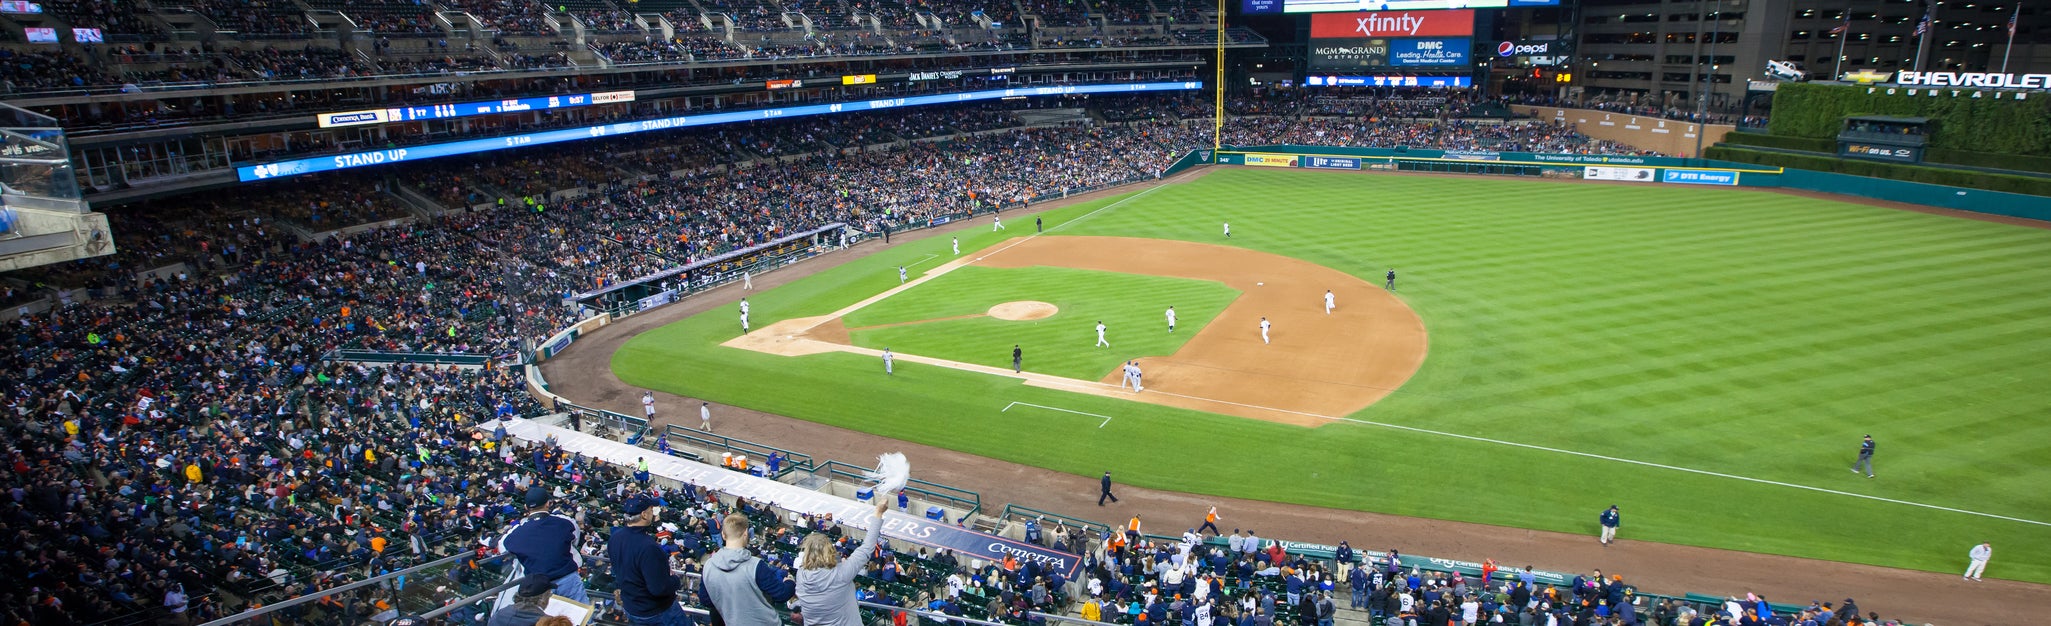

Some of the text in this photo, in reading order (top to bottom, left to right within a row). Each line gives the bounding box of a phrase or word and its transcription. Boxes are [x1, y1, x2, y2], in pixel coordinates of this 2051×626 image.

[1355, 12, 1425, 36] xfinity
[1315, 46, 1384, 55] MGM GRAND
[1417, 41, 1443, 50] DMC
[1515, 43, 1548, 55] pepsi
[896, 98, 905, 106] UP
[642, 119, 670, 130] STAND
[673, 117, 686, 126] UP
[1869, 147, 1879, 155] on
[334, 149, 407, 168] STAND UP
[1313, 157, 1328, 167] Lite
[1546, 155, 1574, 163] University
[1680, 172, 1731, 183] DTE Energy
[716, 474, 829, 510] DETROIT
[1199, 612, 1209, 621] 24
